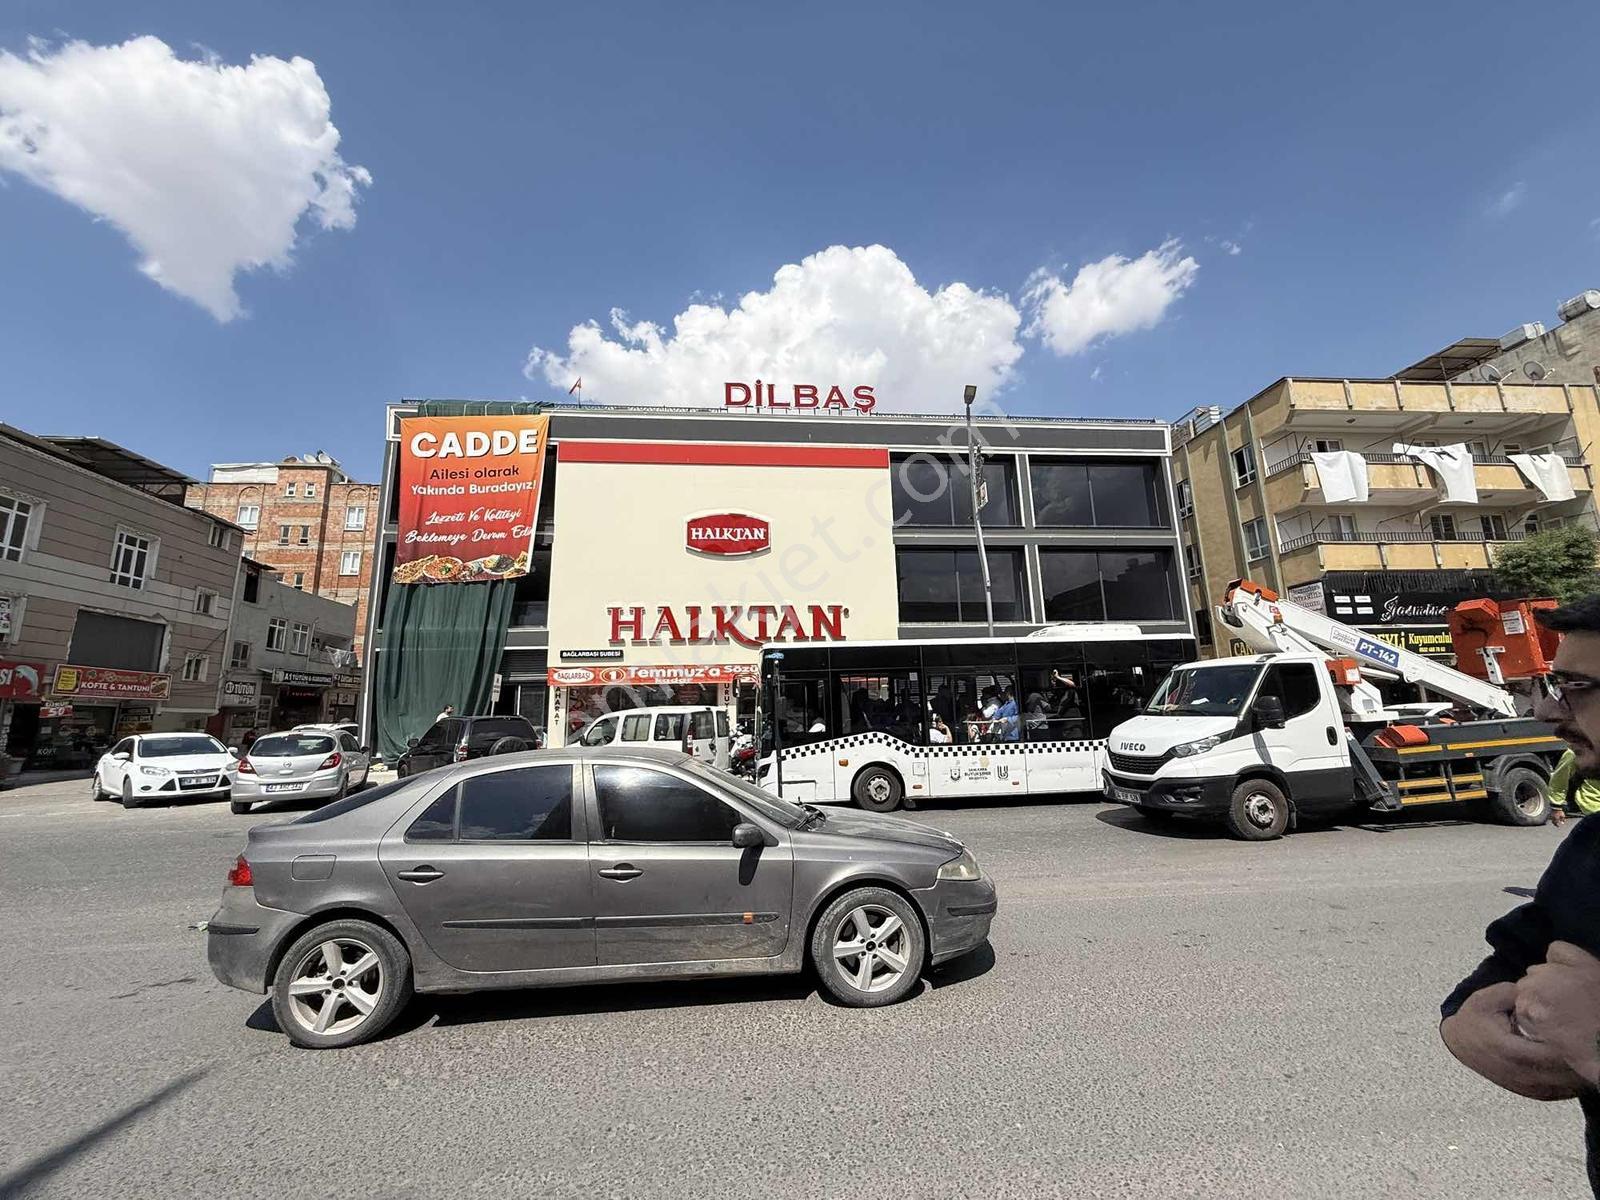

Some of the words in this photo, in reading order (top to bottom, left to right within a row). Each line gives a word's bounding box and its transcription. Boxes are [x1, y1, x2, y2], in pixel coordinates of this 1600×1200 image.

[725, 379, 876, 413] DİLBAŞ
[411, 429, 538, 458] CADDE
[430, 467, 469, 480] Ailesi
[474, 465, 520, 478] olarak
[412, 483, 465, 496] Yakında
[469, 480, 537, 494] Buradayız!
[467, 506, 485, 522] Ve
[691, 527, 766, 541] HALKTAN
[607, 605, 848, 650] HALKTAN
[1359, 642, 1397, 663] PT-142
[627, 666, 720, 679] Temmuz'a
[724, 664, 758, 674] Sözü
[1120, 742, 1146, 751] IVECO
